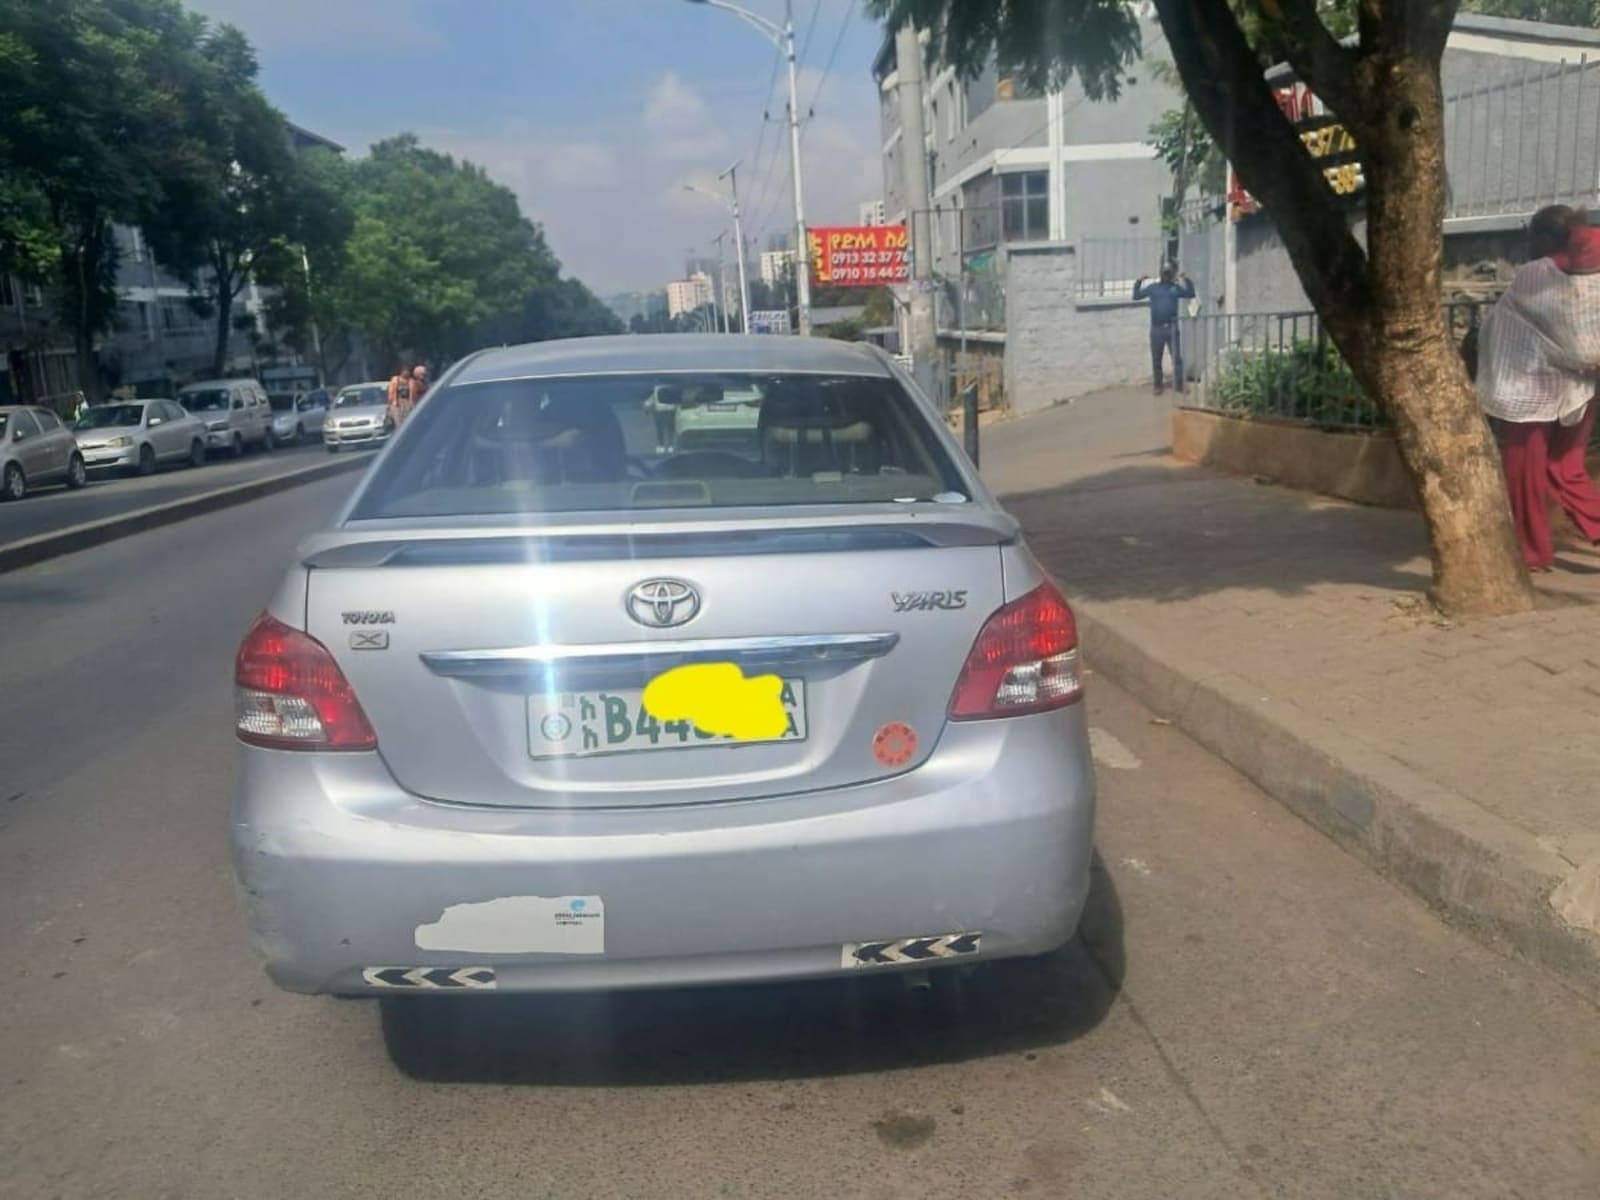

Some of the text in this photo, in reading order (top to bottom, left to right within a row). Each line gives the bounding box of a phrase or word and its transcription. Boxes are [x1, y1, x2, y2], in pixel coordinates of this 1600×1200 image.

[832, 251, 859, 264] 0913
[862, 251, 877, 263] 32
[879, 251, 893, 263] 37
[832, 266, 909, 280] 0910 15 44 27
[890, 590, 969, 612] YARIS
[341, 610, 396, 625] TOYOTA
